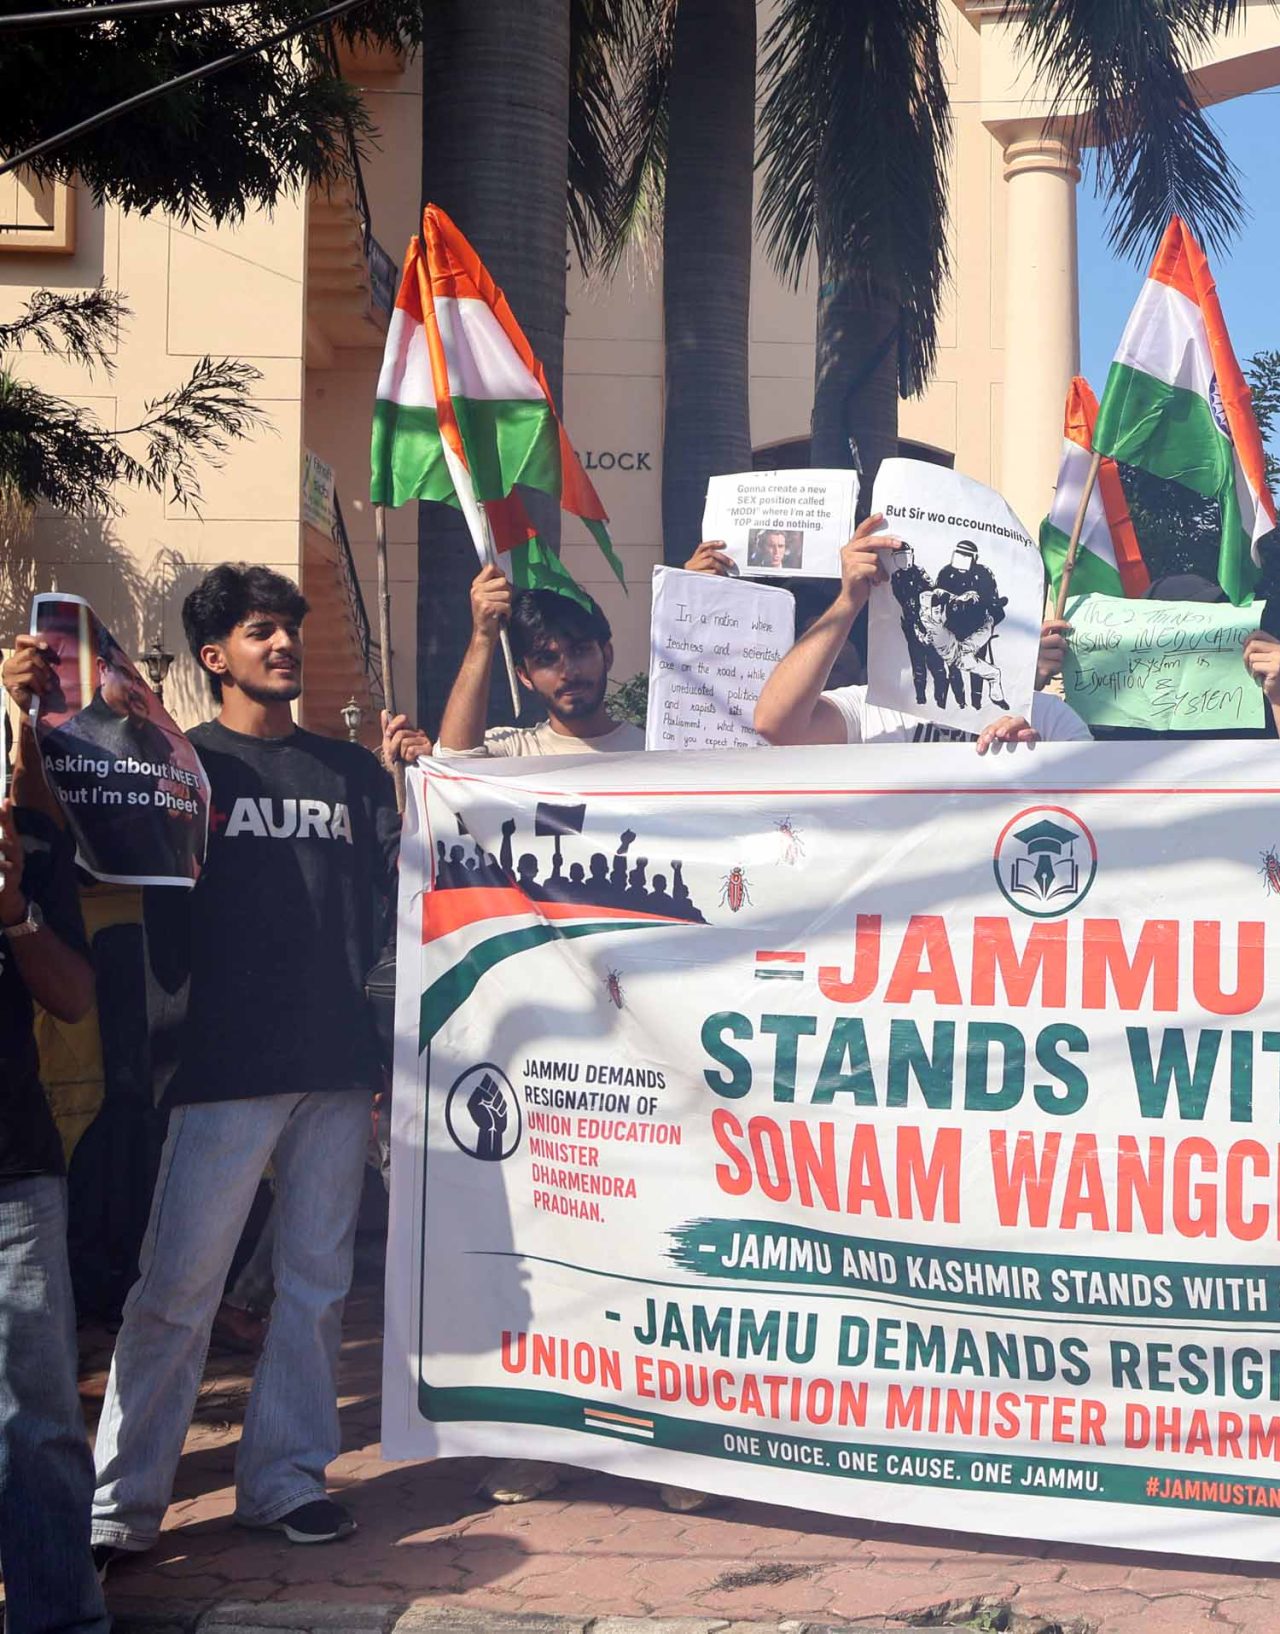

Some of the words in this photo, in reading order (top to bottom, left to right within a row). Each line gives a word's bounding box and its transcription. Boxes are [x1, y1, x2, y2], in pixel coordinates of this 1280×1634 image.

[574, 450, 652, 470] LOCK
[737, 484, 766, 494] Gonna
[768, 484, 798, 494] create
[799, 486, 806, 494] a
[807, 486, 827, 495] new
[737, 496, 757, 505] SEX
[758, 496, 796, 507] position
[798, 496, 825, 506] called
[734, 518, 752, 527] TOP
[753, 518, 771, 527] and
[772, 518, 785, 528] do
[786, 520, 824, 531] nothing.
[762, 507, 789, 516] where
[805, 509, 815, 517] at
[816, 509, 831, 518] the
[886, 504, 906, 518] But
[909, 507, 925, 520] Sir
[927, 511, 946, 524] wo
[947, 516, 1033, 547] accountability?
[676, 603, 692, 623] In
[700, 615, 707, 624] a
[714, 612, 739, 628] nation
[752, 614, 773, 633] where
[665, 635, 704, 653] teachers
[713, 642, 731, 656] and
[1068, 631, 1123, 653] ISSING
[1133, 627, 1154, 650] IN
[1156, 626, 1253, 652] EDUCATIO
[659, 659, 675, 670] are
[681, 663, 692, 672] on
[698, 662, 710, 674] the
[747, 669, 766, 681] while
[664, 700, 680, 710] and
[691, 702, 717, 717] rapists
[671, 683, 714, 697] uneducated
[727, 687, 759, 705] politicia
[1151, 686, 1244, 719] SYSTEM
[662, 731, 675, 741] can
[683, 736, 697, 747] you
[705, 737, 728, 748] expect
[717, 720, 734, 732] what
[44, 753, 109, 778] Asking
[114, 757, 168, 779] about
[169, 764, 200, 790] NEET
[58, 787, 88, 804] but
[92, 788, 122, 805] I'm
[127, 790, 149, 806] so
[153, 790, 199, 815] Dheet
[818, 913, 1266, 1016] JAMMU
[523, 1059, 579, 1082] JAMMU
[586, 1065, 666, 1090] DEMANDS
[700, 1011, 1090, 1117] STANDS
[524, 1085, 631, 1114] RESIGNATION
[637, 1096, 658, 1116] OF
[527, 1111, 571, 1137] UNION
[577, 1118, 682, 1145] EDUCATION
[529, 1137, 599, 1168] MINISTER
[711, 1106, 963, 1224] SONAM
[532, 1163, 637, 1199] DHARMENDRA
[533, 1190, 605, 1223] PRADHAN.
[722, 1233, 832, 1276] JAMMU
[843, 1247, 898, 1287] AND
[907, 1256, 1042, 1301] KASHMIR
[1052, 1268, 1173, 1310] STANDS
[1184, 1275, 1270, 1315] WITH
[634, 1298, 816, 1364] JAMMU
[837, 1316, 1090, 1386] DEMANDS
[501, 1330, 623, 1392] UNION
[635, 1355, 867, 1428] EDUCATION
[885, 1383, 1106, 1447] MINISTER
[723, 1432, 761, 1458] ONE
[767, 1439, 832, 1468] VOICE.
[838, 1449, 879, 1473] ONE
[885, 1455, 963, 1481] CAUSE.
[970, 1461, 1012, 1485] ONE
[1019, 1464, 1105, 1493] JAMMU.
